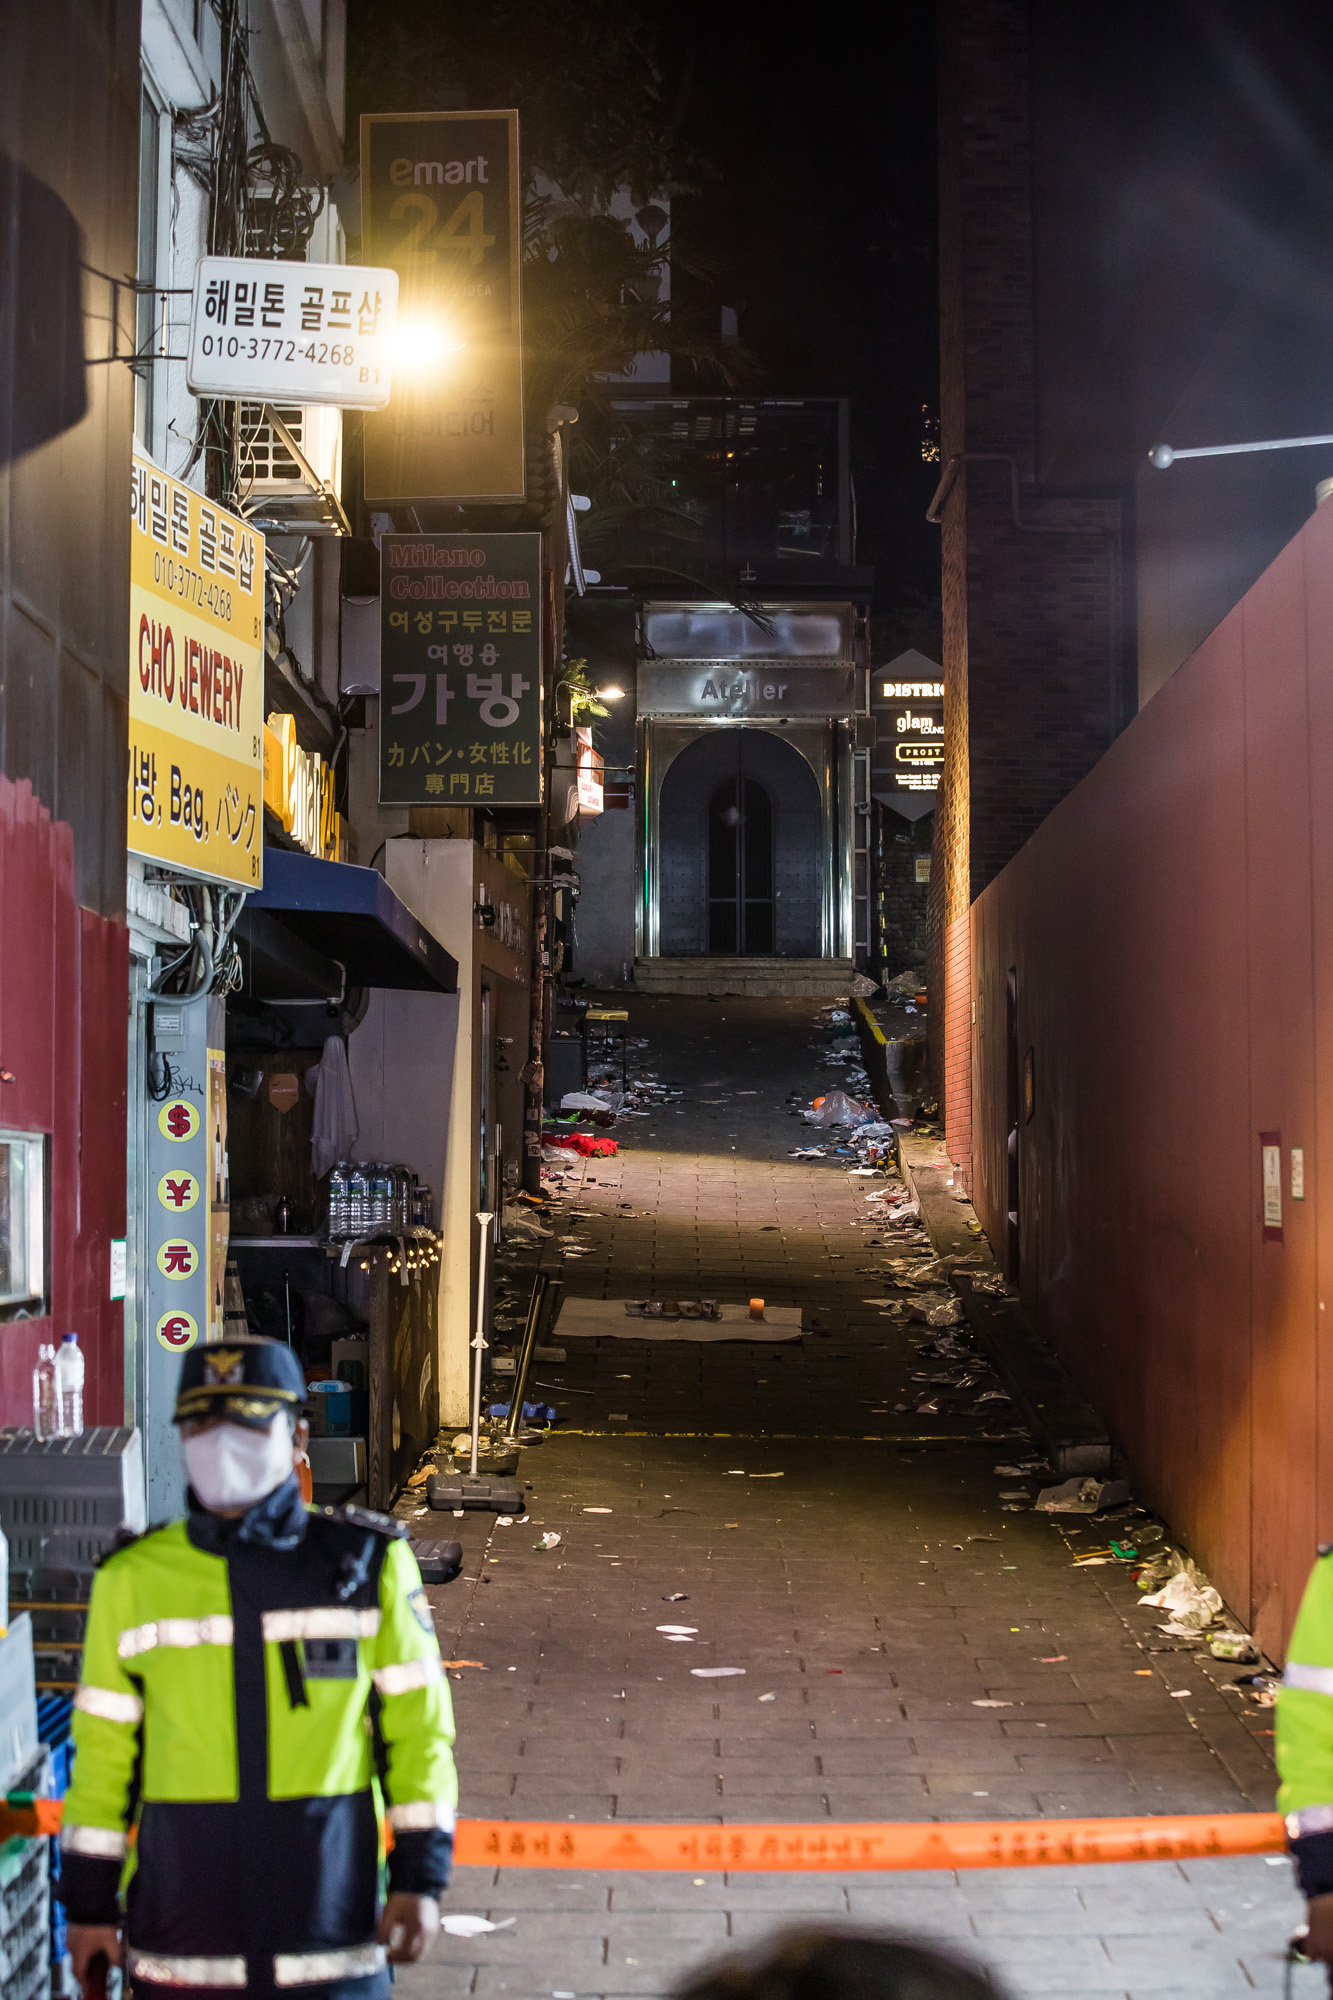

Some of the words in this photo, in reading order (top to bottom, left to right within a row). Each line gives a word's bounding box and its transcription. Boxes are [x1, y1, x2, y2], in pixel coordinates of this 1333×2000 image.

[390, 155, 489, 185] emart
[389, 190, 496, 266] 24
[204, 280, 286, 328] 해밀톤
[300, 286, 382, 336] 골프샵
[202, 335, 355, 366] 010-3772-4268
[199, 505, 255, 596] 골프샵
[389, 543, 486, 568] Milano
[154, 551, 232, 622] 010-3772-4268
[389, 575, 531, 600] Collection
[253, 616, 263, 641] B1
[388, 610, 533, 634] 여성구두전문
[427, 643, 500, 667] 여행용
[139, 614, 176, 702] CHO
[180, 634, 244, 733] JEWERY
[391, 673, 531, 728] 가방
[700, 679, 787, 701] Atelier
[897, 710, 933, 732] glam
[252, 735, 261, 760] B1
[905, 748, 941, 757] PROST
[170, 764, 209, 844] Bag,
[251, 854, 260, 879] B1
[164, 1245, 191, 1273] 元
